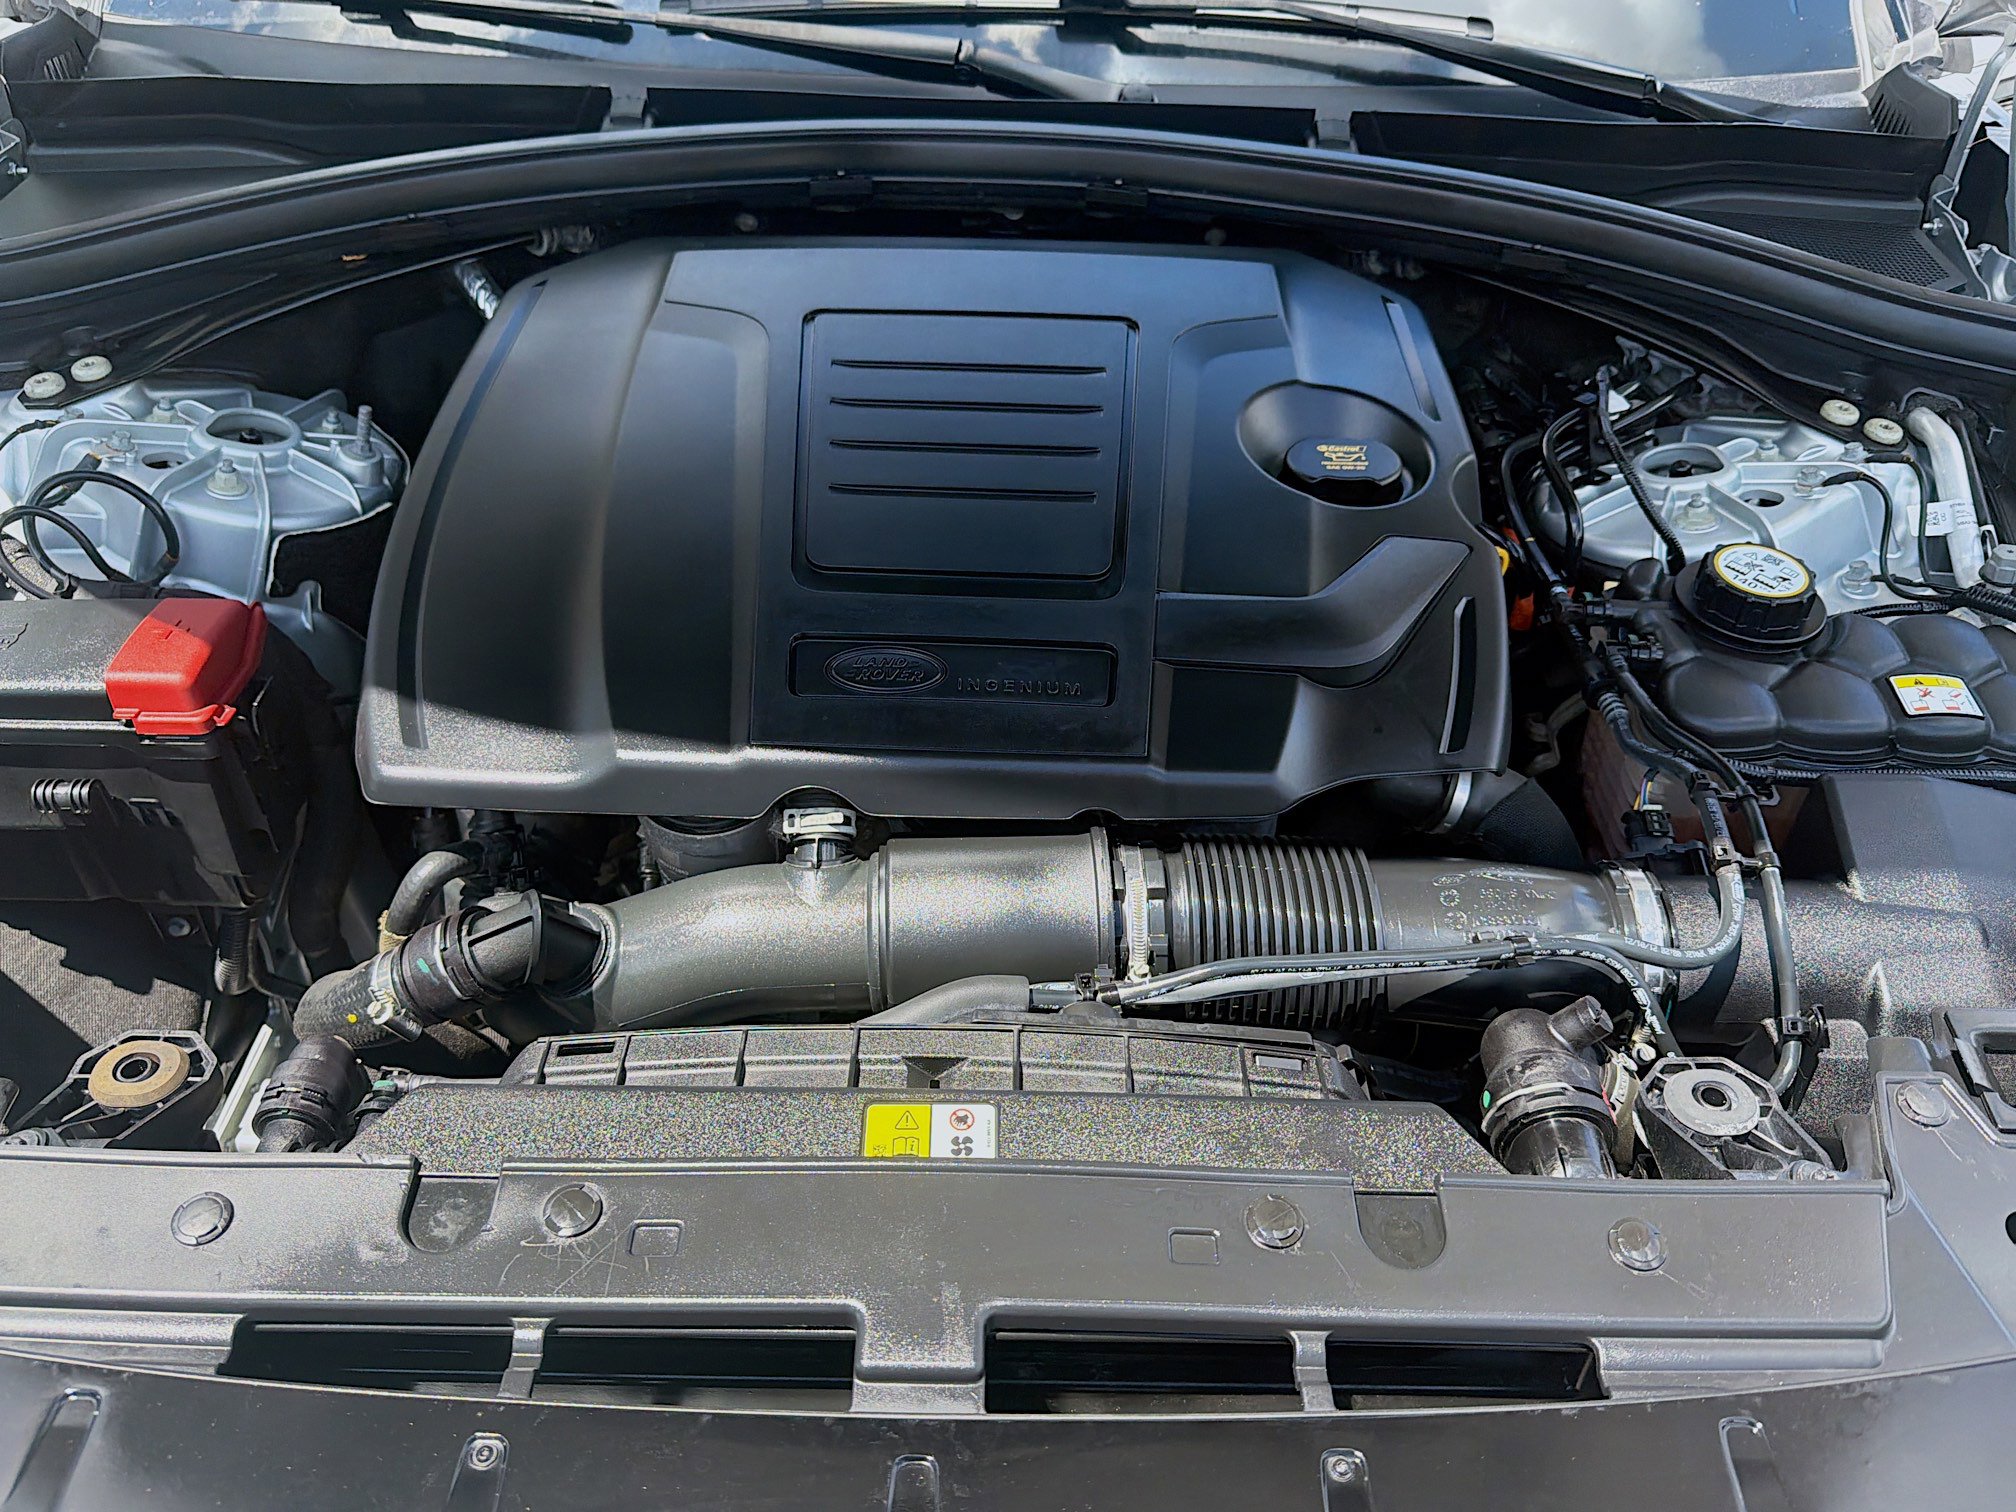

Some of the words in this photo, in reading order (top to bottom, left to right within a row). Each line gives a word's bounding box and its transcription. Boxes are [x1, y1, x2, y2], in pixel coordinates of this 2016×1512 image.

[1733, 574, 1758, 589] 140
[852, 656, 908, 668] LAND
[855, 668, 925, 682] ROVER
[957, 677, 1082, 696] INGENIUM
